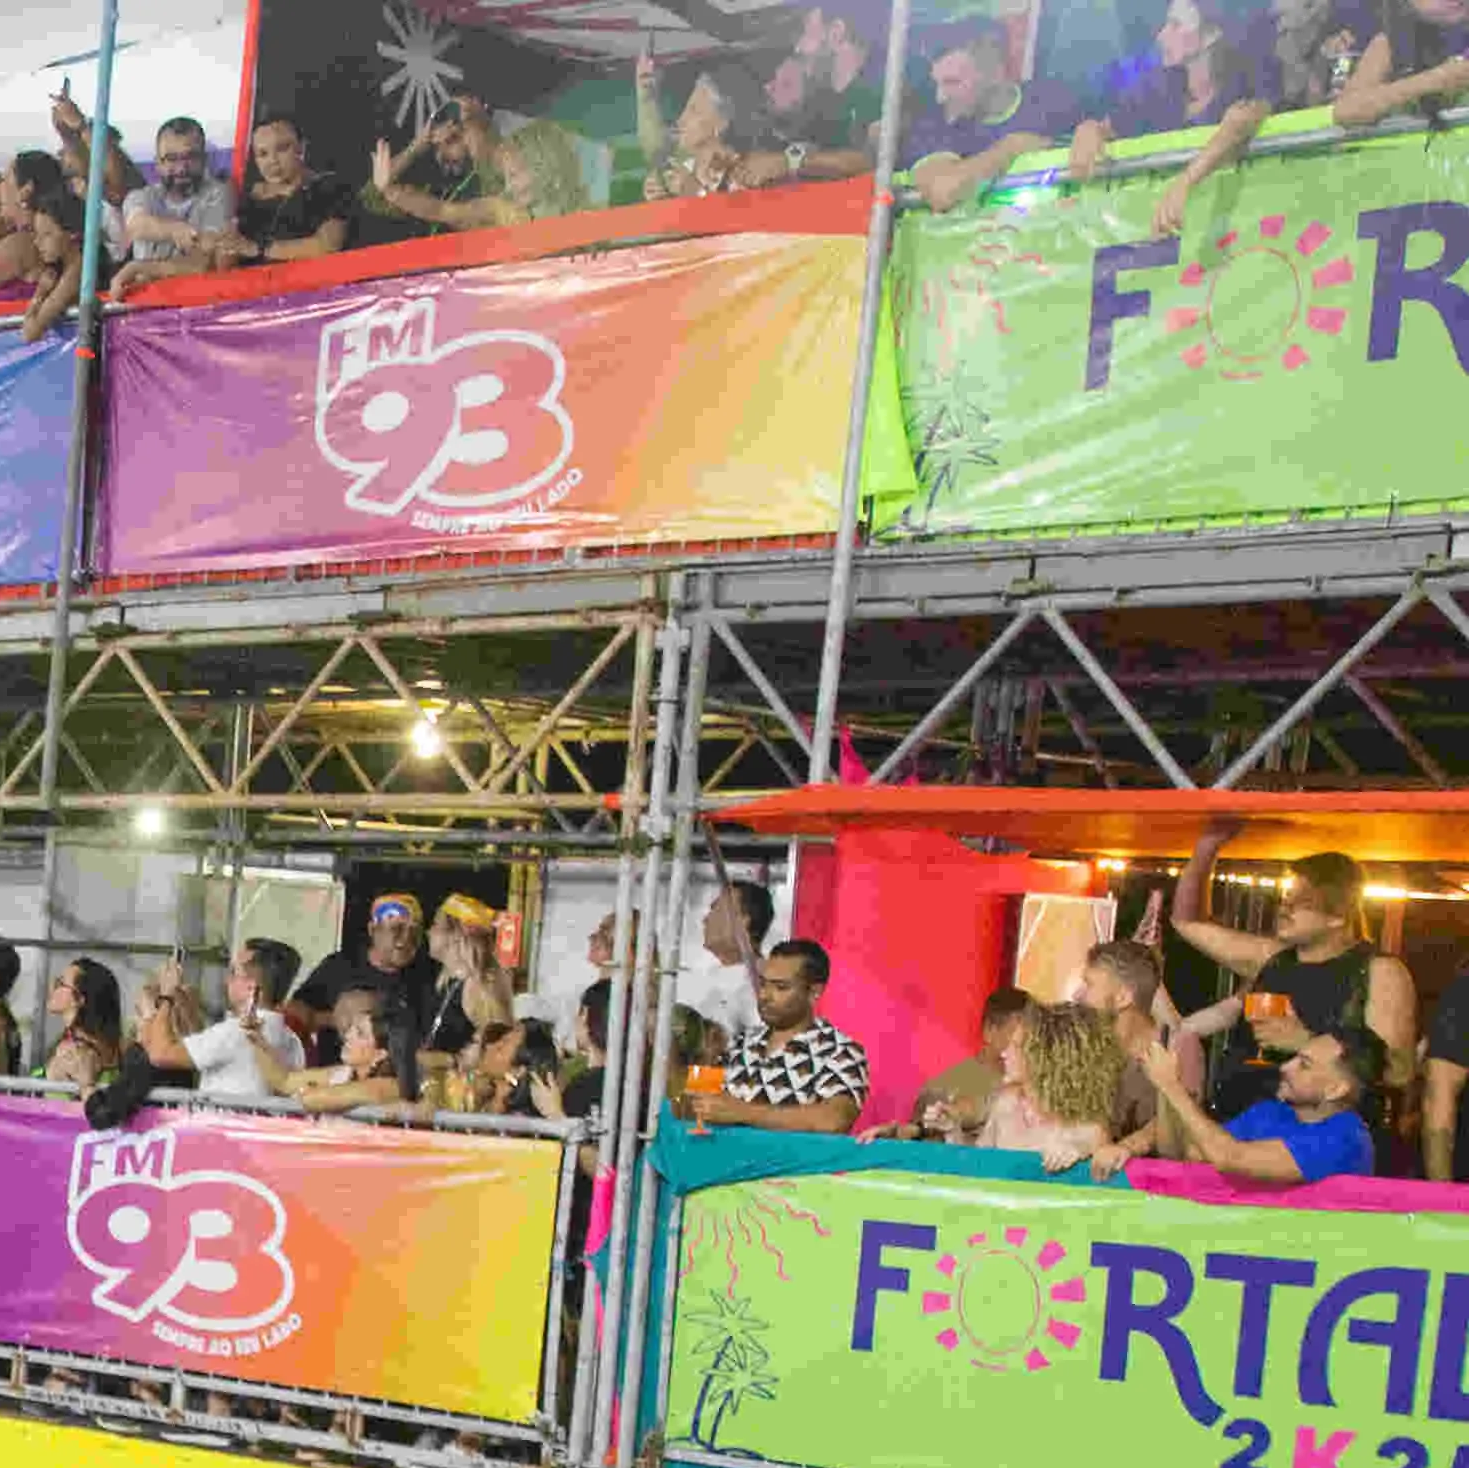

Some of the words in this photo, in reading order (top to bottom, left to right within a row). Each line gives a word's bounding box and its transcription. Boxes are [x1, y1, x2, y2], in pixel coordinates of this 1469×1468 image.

[315, 329, 574, 516] 93
[71, 1128, 176, 1200] FM
[66, 1169, 295, 1323] 93
